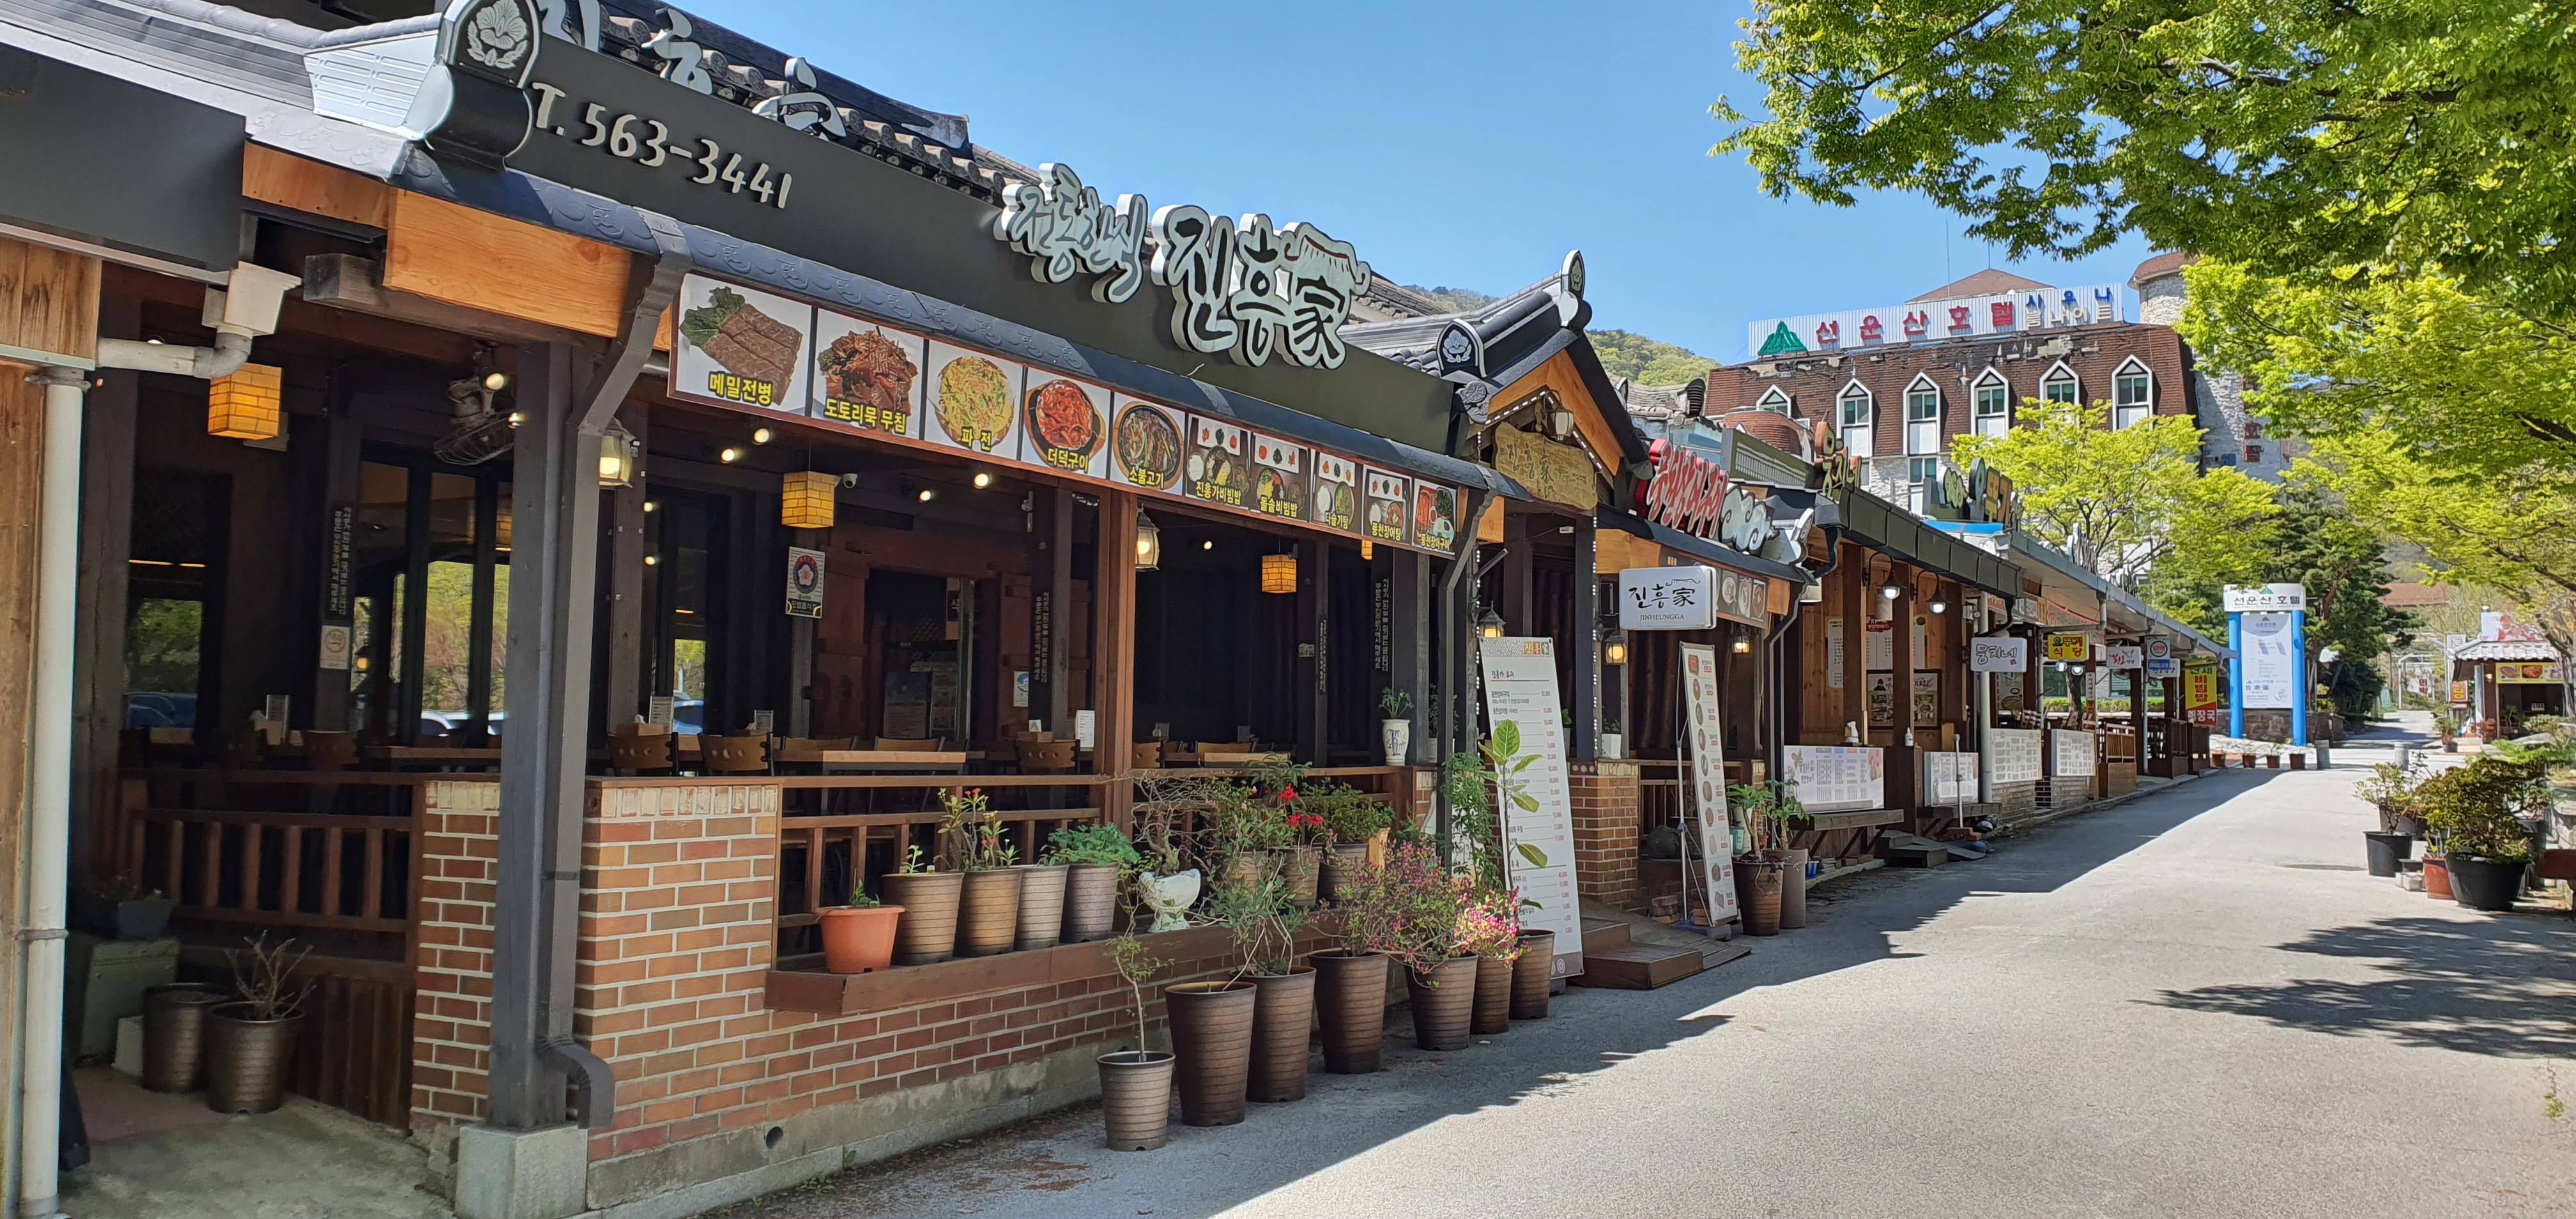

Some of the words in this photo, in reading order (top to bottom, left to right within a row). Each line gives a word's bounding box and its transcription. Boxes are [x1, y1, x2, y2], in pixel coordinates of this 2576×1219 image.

[532, 81, 567, 136] T.
[579, 102, 793, 210] 563-3441
[1155, 206, 1349, 369] 진흥家
[2026, 287, 2112, 308] 사우나
[708, 372, 774, 406] 메밀전병
[824, 397, 878, 429] 도토리묵
[880, 409, 907, 436] 무침
[1047, 448, 1089, 473] 더덕구이
[1128, 468, 1165, 490] 소불고기
[1195, 482, 1242, 506] 진흥가비빔밥
[1259, 496, 1298, 518] 돌솥비빔밥
[1324, 512, 1349, 530] 다슬기탕
[1370, 522, 1402, 541] 풍천장어탕
[1420, 533, 1451, 552] 풍천장어구이
[1627, 581, 1696, 610] 진흥家
[2234, 595, 2272, 605] 선운산
[2276, 595, 2300, 604] 호텔
[1639, 613, 1685, 622] JINHEUNGGA
[2052, 636, 2083, 647] 오뚜기
[1975, 643, 2018, 665] 뭉치네
